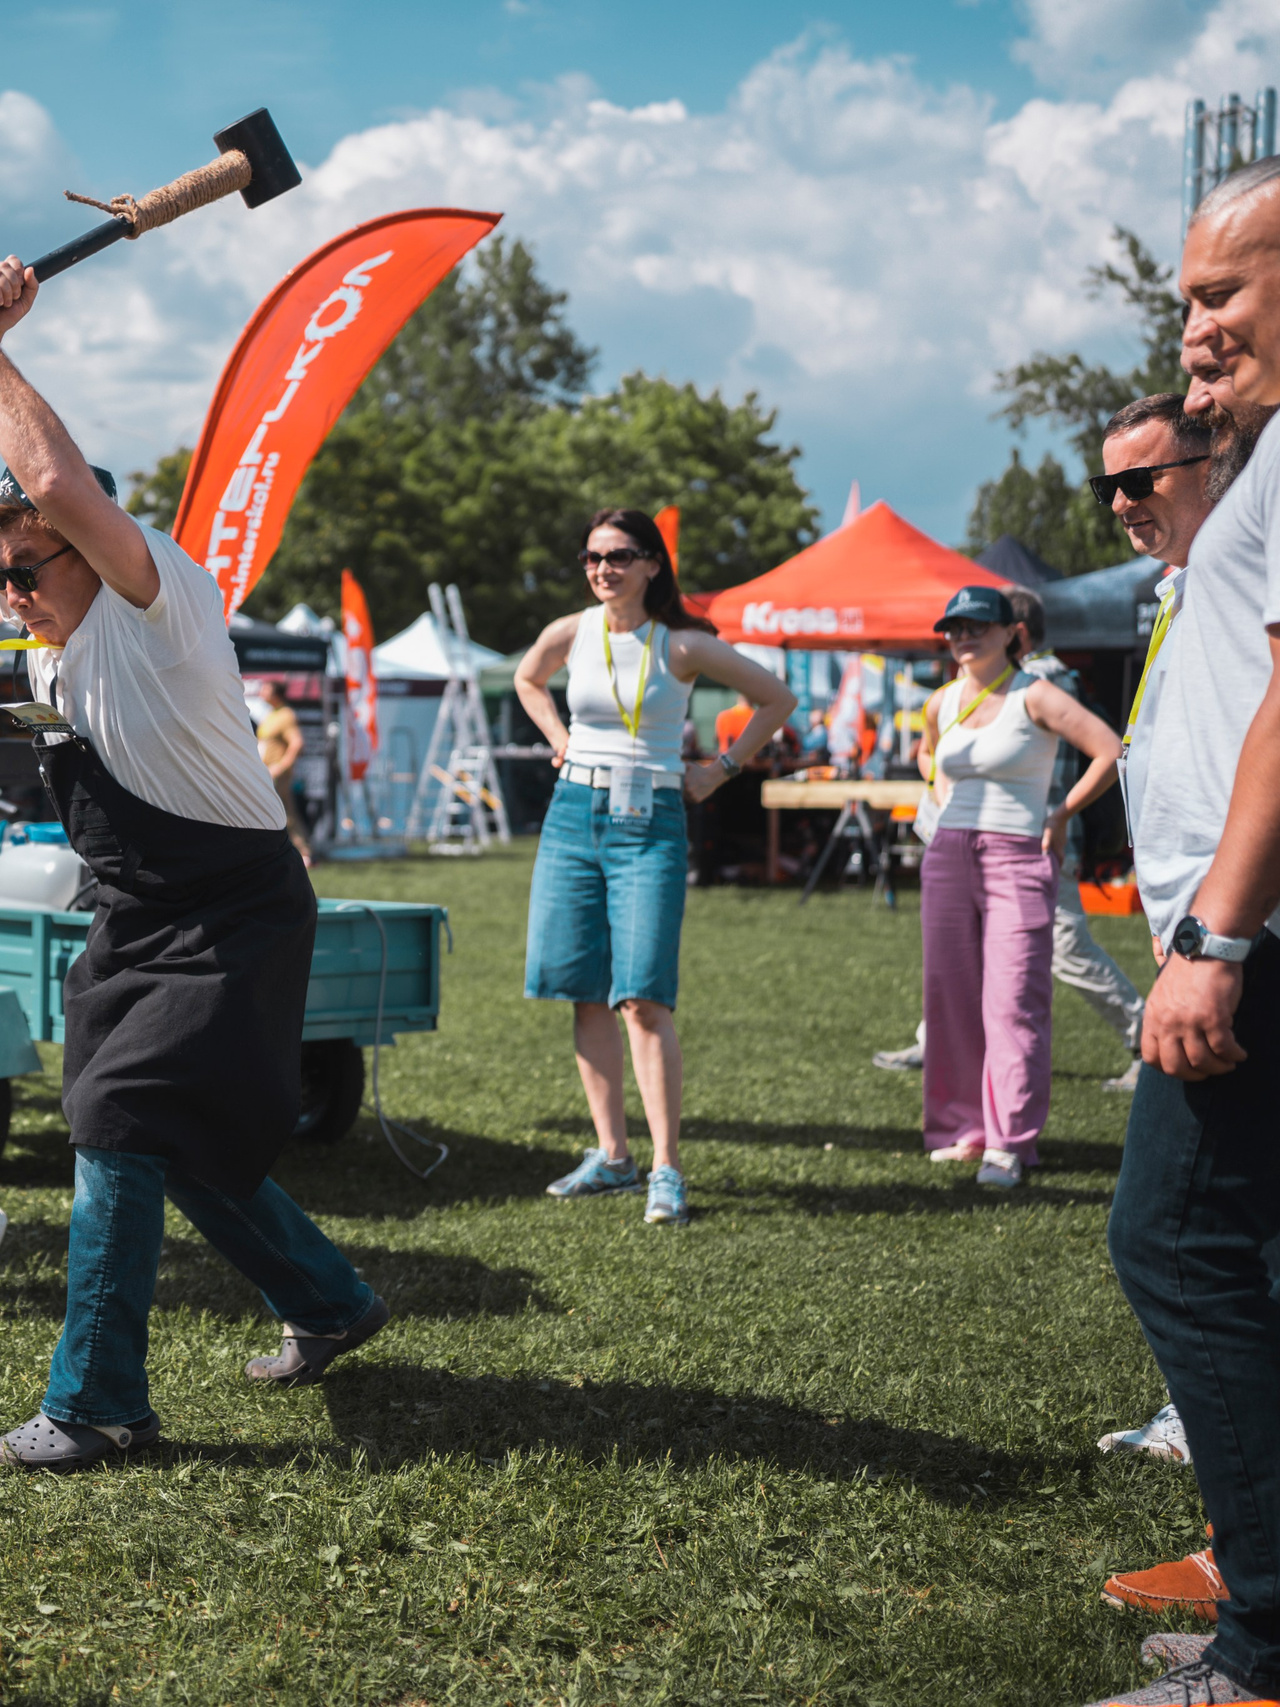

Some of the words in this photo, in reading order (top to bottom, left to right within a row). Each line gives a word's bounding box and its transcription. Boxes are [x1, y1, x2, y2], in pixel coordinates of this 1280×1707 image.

[204, 249, 394, 601] НТЕРСКОЛ
[224, 452, 281, 620] w.interskol.ru
[31, 724, 73, 733] HYUNDAI
